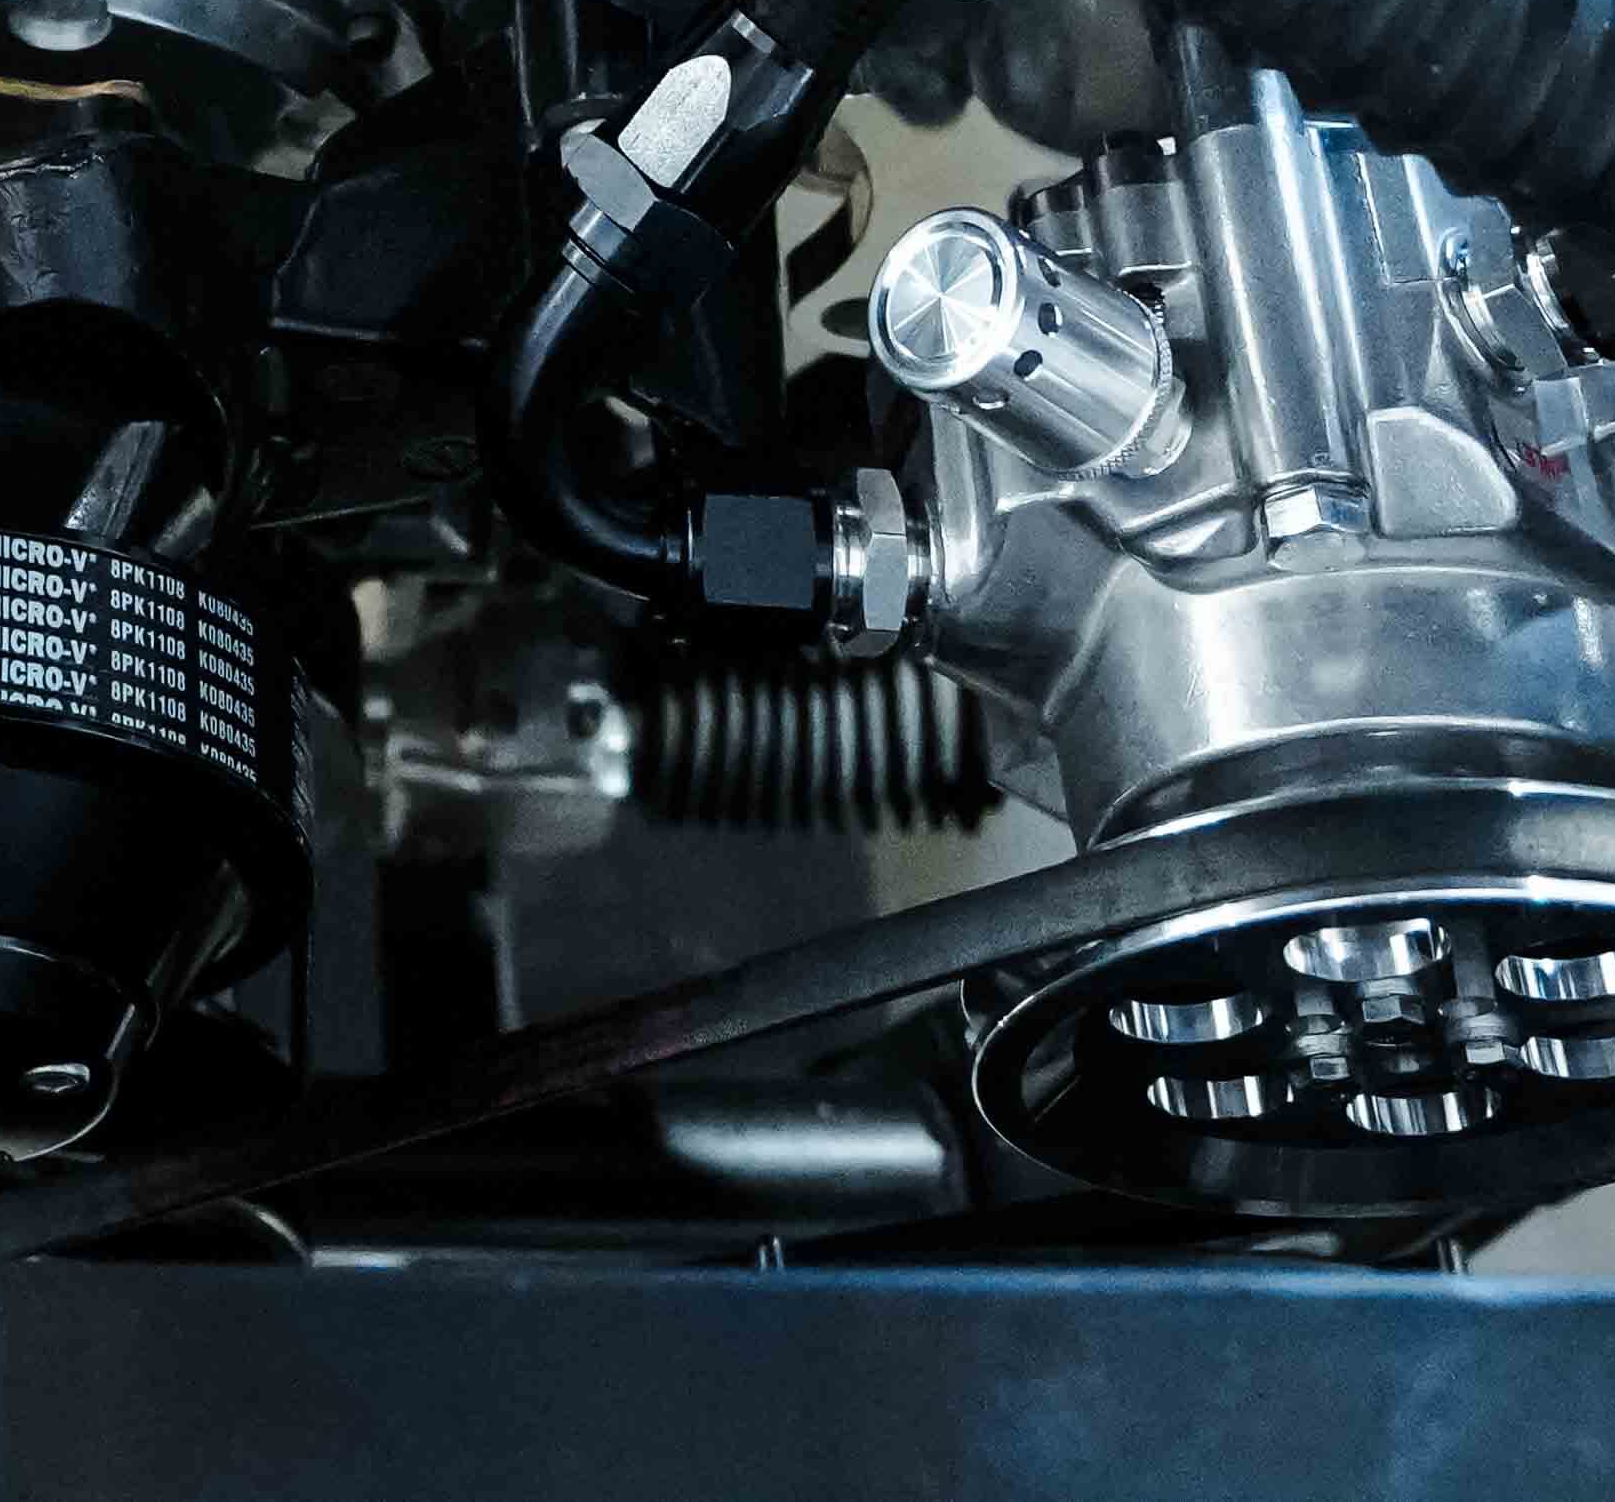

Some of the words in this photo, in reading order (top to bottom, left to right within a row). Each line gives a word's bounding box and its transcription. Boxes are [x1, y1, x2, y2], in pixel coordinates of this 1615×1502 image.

[110, 589, 186, 631] 8PK1108
[197, 619, 255, 667] K080435
[110, 618, 186, 660] 8PK1108
[198, 649, 255, 696] K080435
[110, 650, 187, 692] 8PK1108
[198, 679, 256, 728] K080435
[110, 680, 187, 722] 8PK1108
[199, 709, 256, 759] K080435
